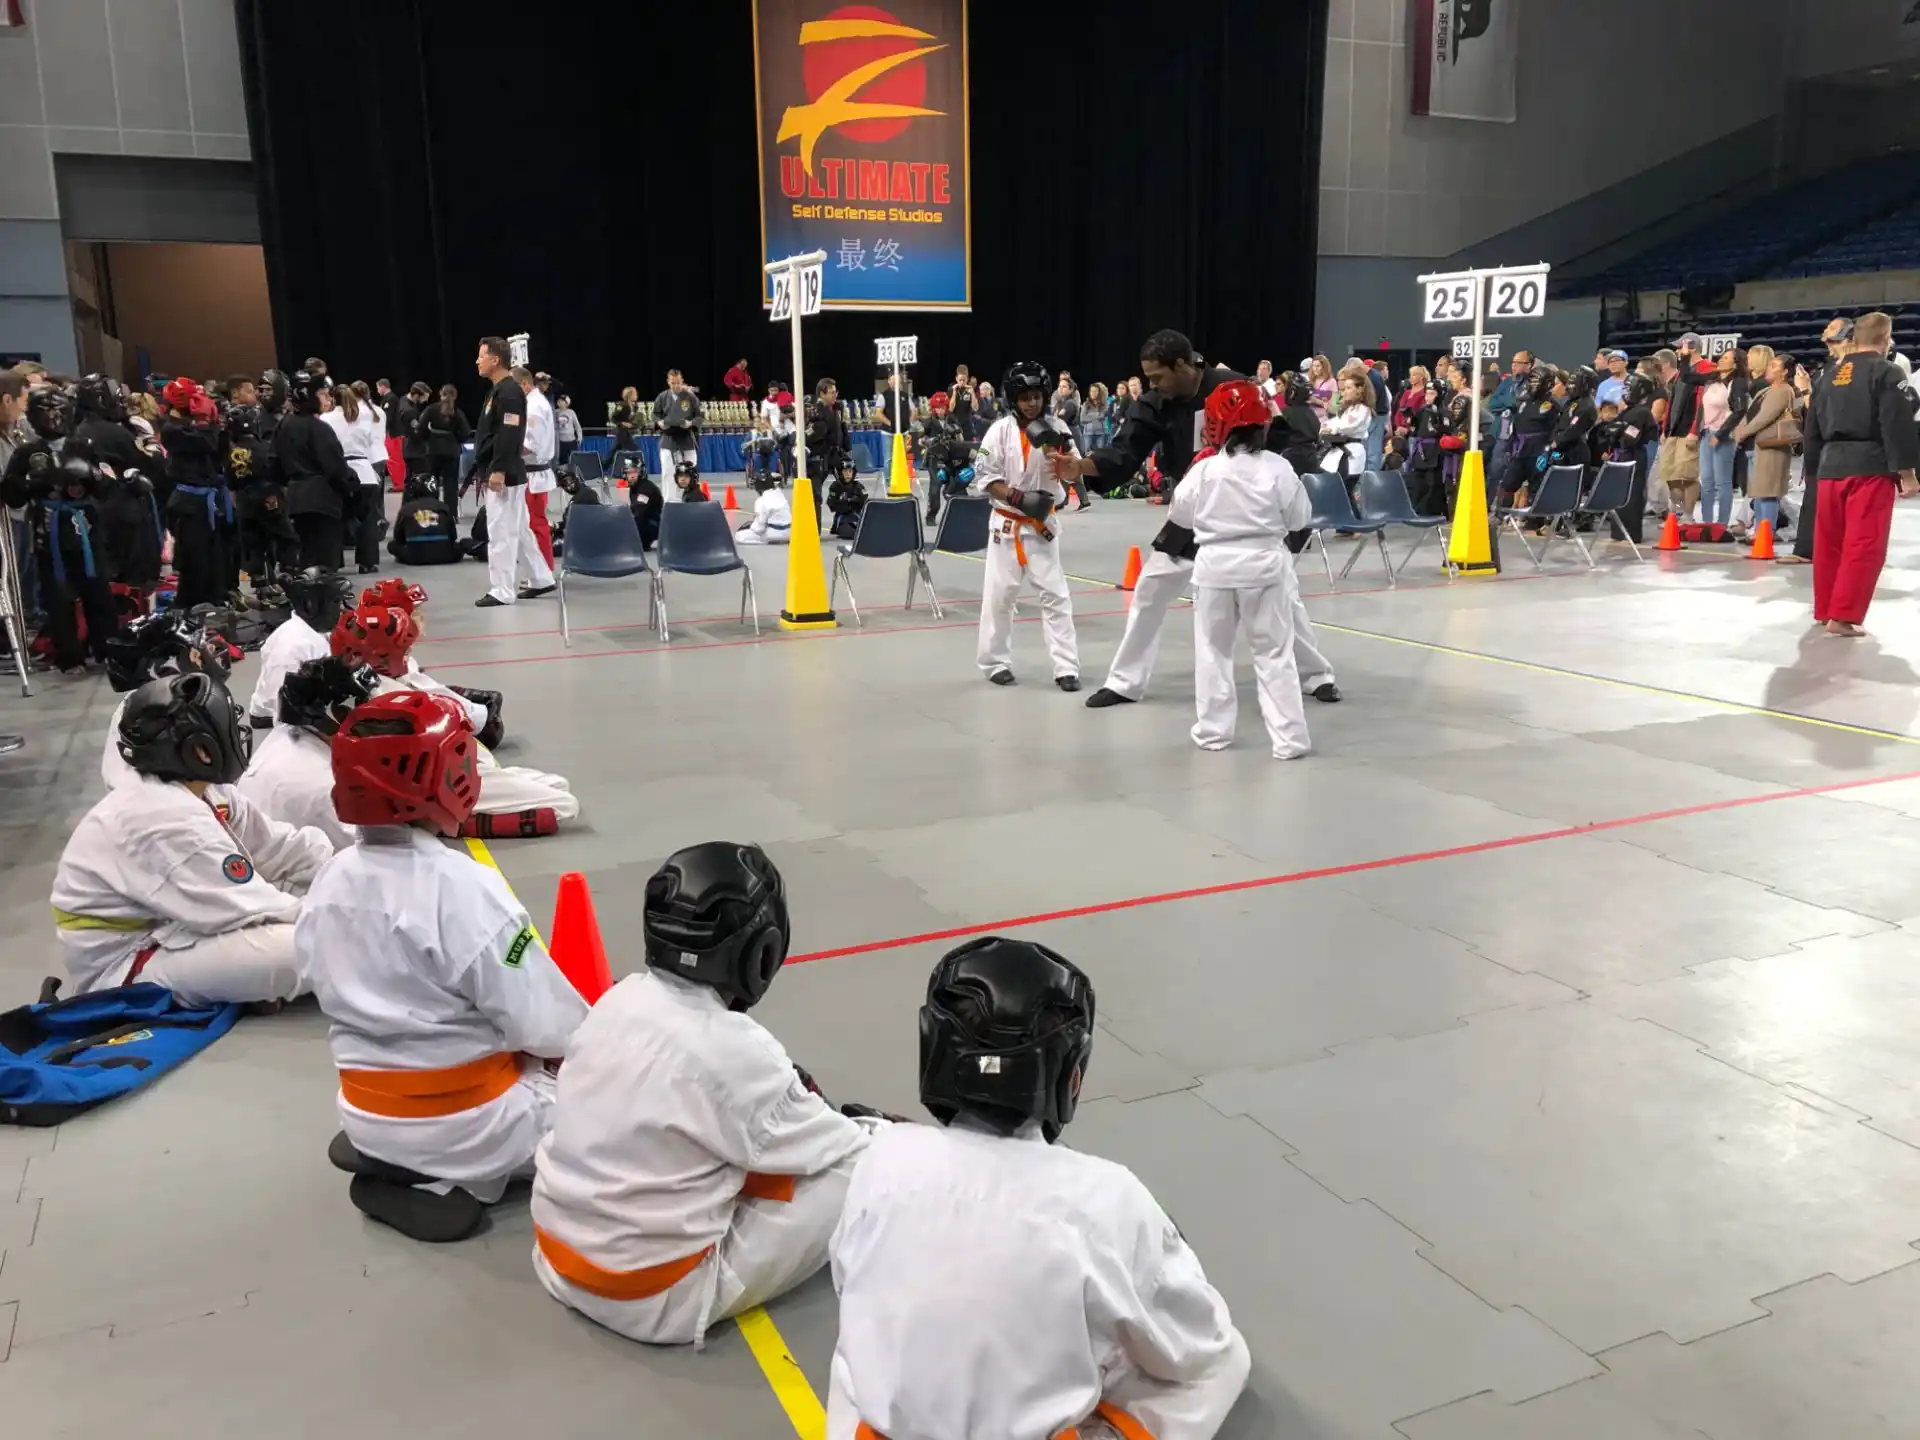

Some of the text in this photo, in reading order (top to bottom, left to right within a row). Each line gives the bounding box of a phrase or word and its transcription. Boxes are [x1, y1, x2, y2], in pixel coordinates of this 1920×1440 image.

[780, 155, 951, 204] ULTIMATE
[792, 204, 943, 223] Self Defense Studios
[773, 278, 791, 318] 26
[804, 270, 819, 313] 19
[1496, 280, 1539, 314] 20
[1431, 286, 1469, 319] 25
[879, 345, 893, 363] 33
[900, 344, 915, 362] 28
[1456, 341, 1471, 357] 32
[1481, 341, 1497, 357] 29
[1715, 340, 1734, 354] 30
